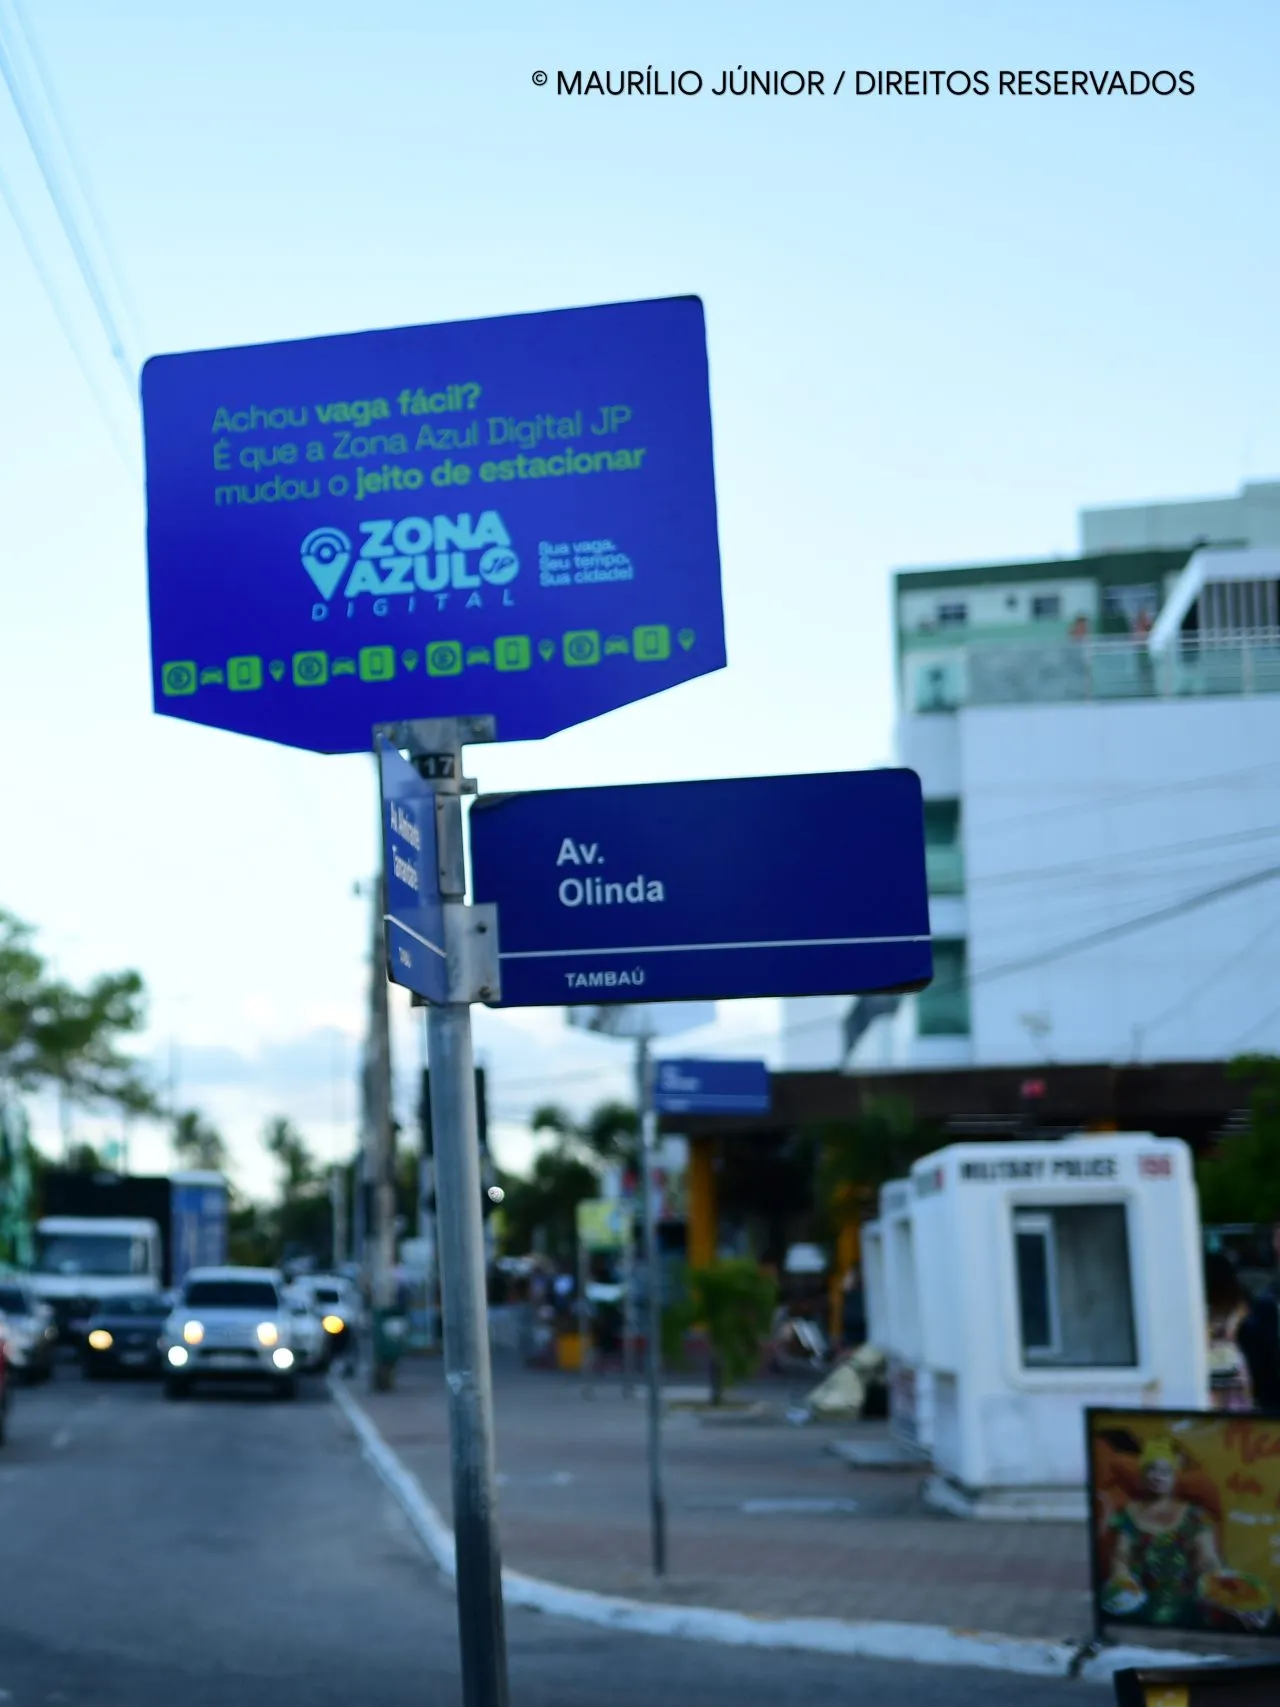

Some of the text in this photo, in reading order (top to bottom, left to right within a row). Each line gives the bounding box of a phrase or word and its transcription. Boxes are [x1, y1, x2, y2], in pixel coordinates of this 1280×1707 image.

[212, 382, 482, 434] Achou vaga fácil?
[213, 405, 632, 473] É que a Zona Azul Digital JP
[214, 446, 647, 506] mudou o jeito de estacionar
[358, 510, 512, 558] ZONA
[539, 539, 617, 556] Sua vaga.
[343, 551, 483, 598] AZUL
[539, 556, 570, 571] Seu
[540, 572, 571, 587] Sua
[311, 588, 516, 622] DIGITAL
[556, 837, 605, 867] Av.
[558, 874, 665, 907] Olinda
[564, 965, 645, 988] TAMBAÚ
